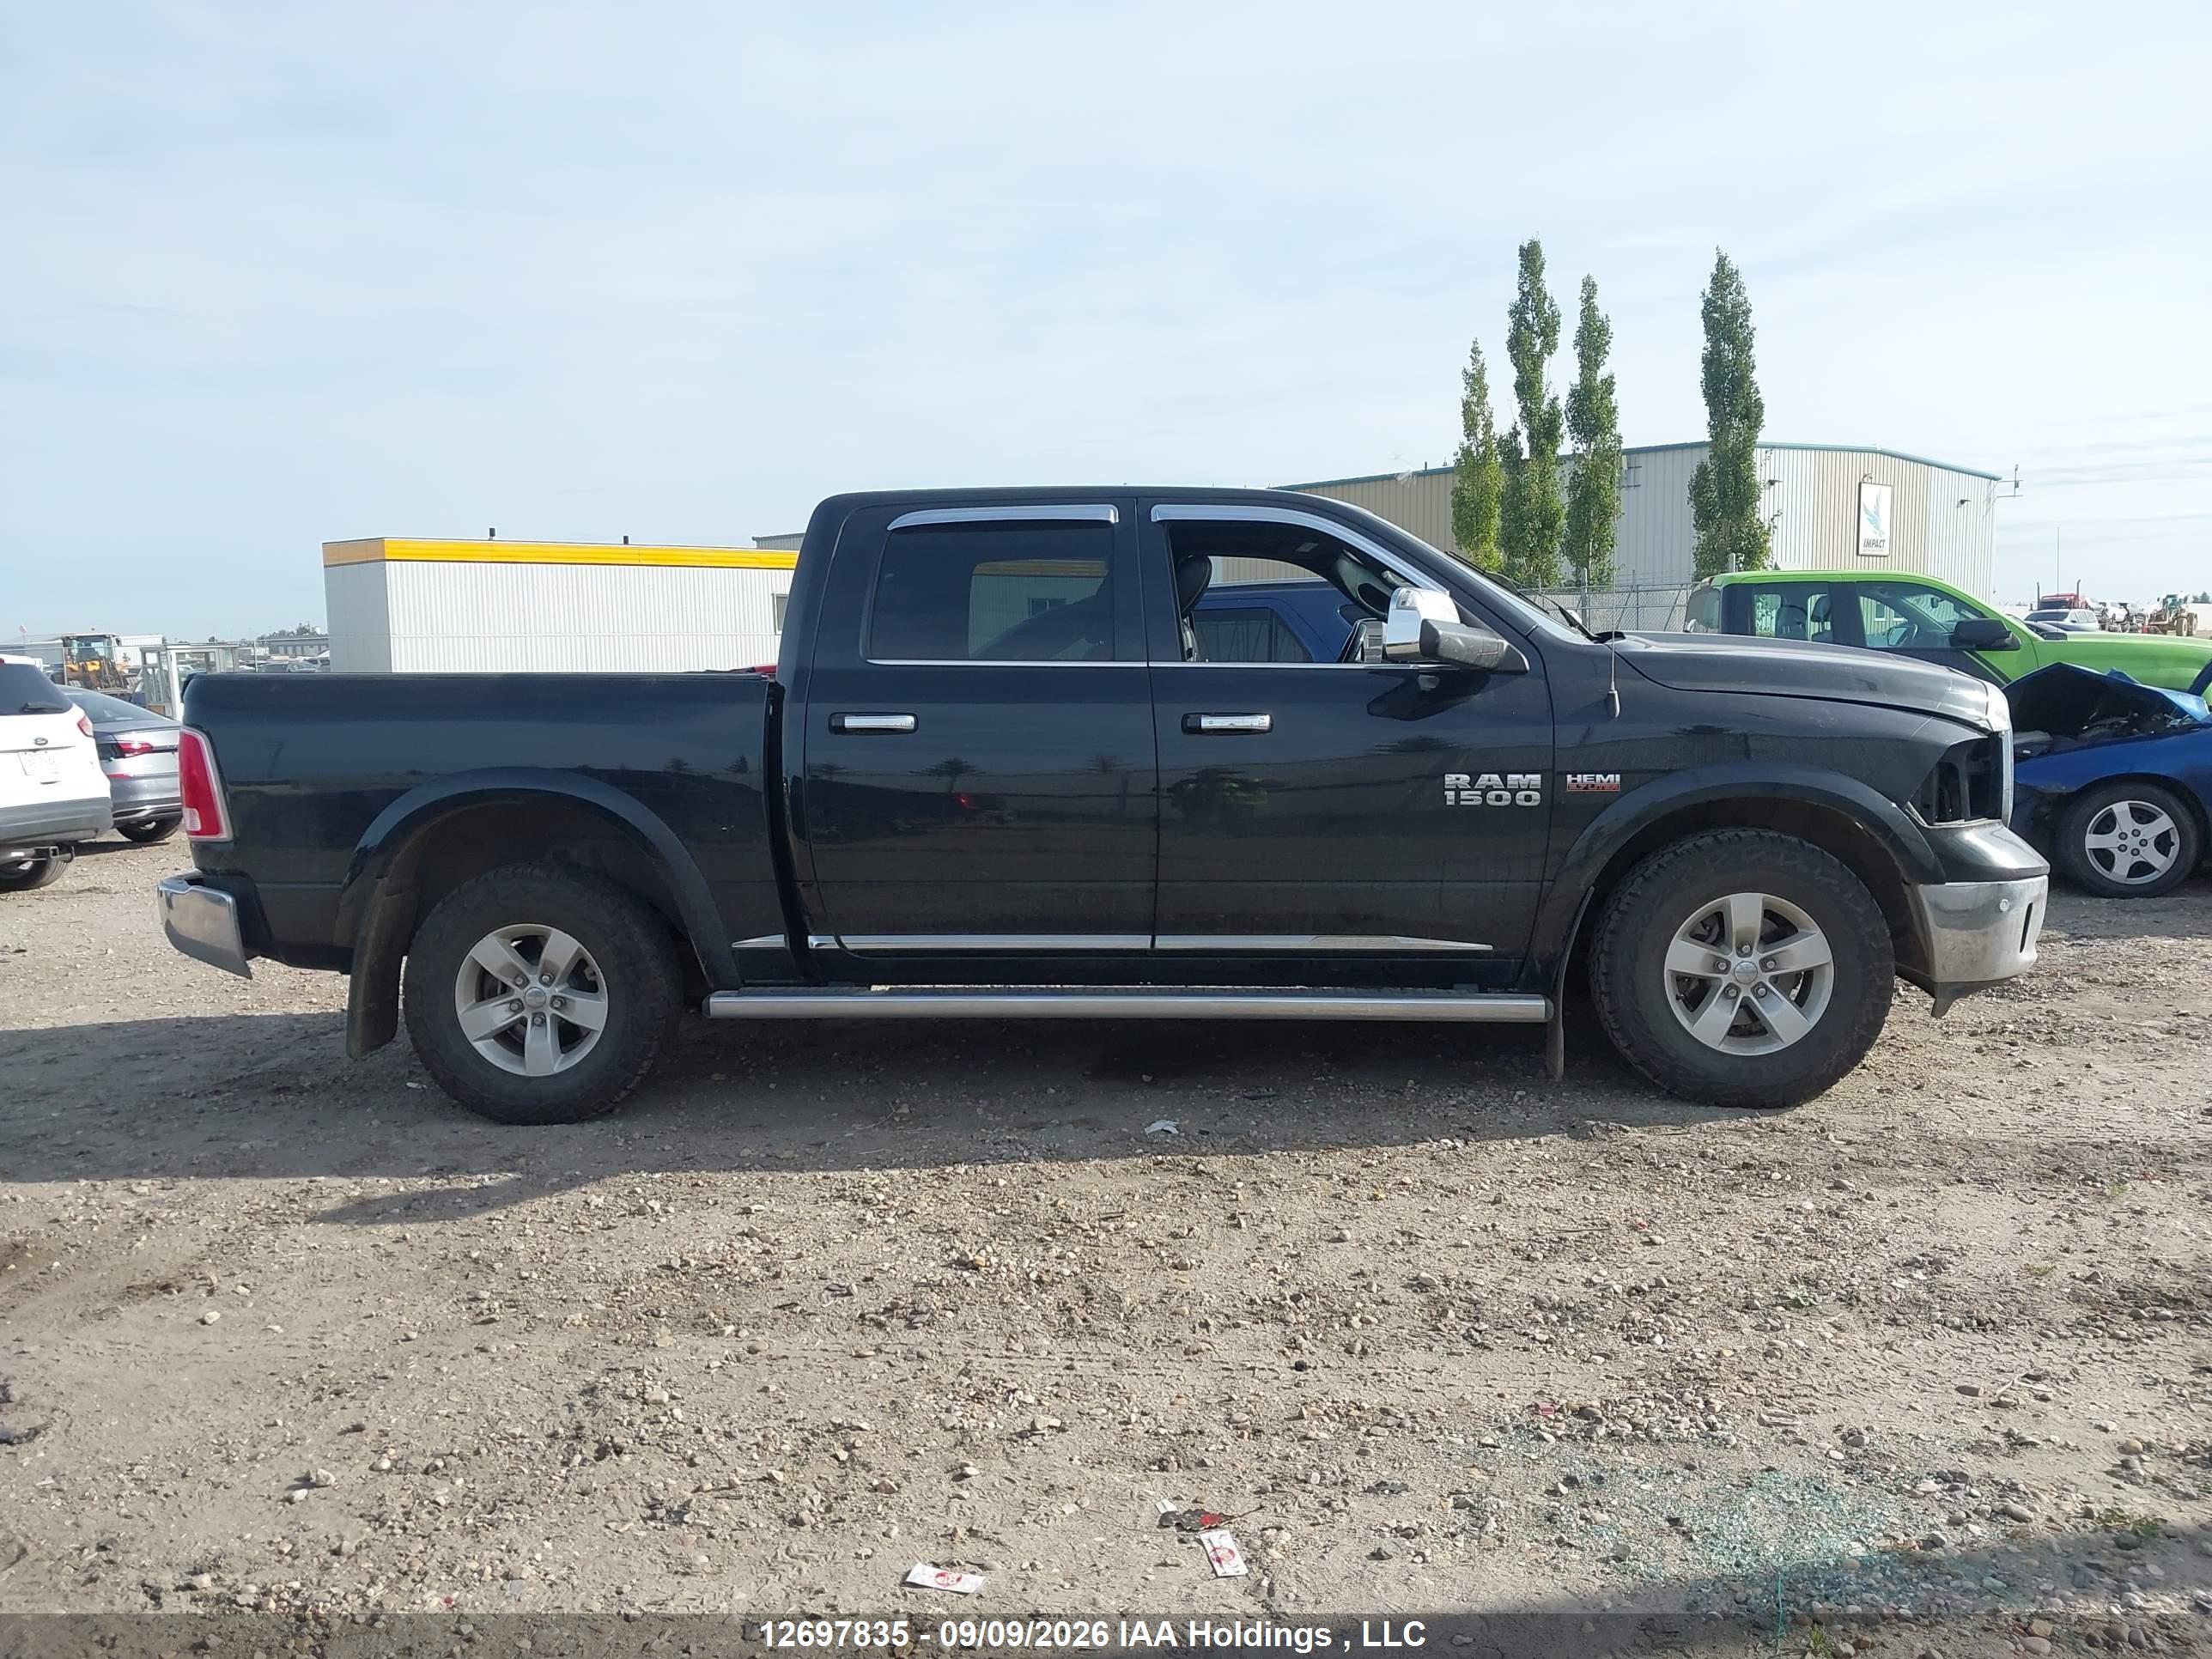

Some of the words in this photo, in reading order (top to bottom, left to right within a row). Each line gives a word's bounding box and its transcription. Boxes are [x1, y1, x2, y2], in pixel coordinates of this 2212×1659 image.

[1863, 538, 1886, 549] IMPACT
[1444, 774, 1541, 789] RAM
[1566, 774, 1620, 784] HEMI
[1444, 790, 1541, 806] 1500
